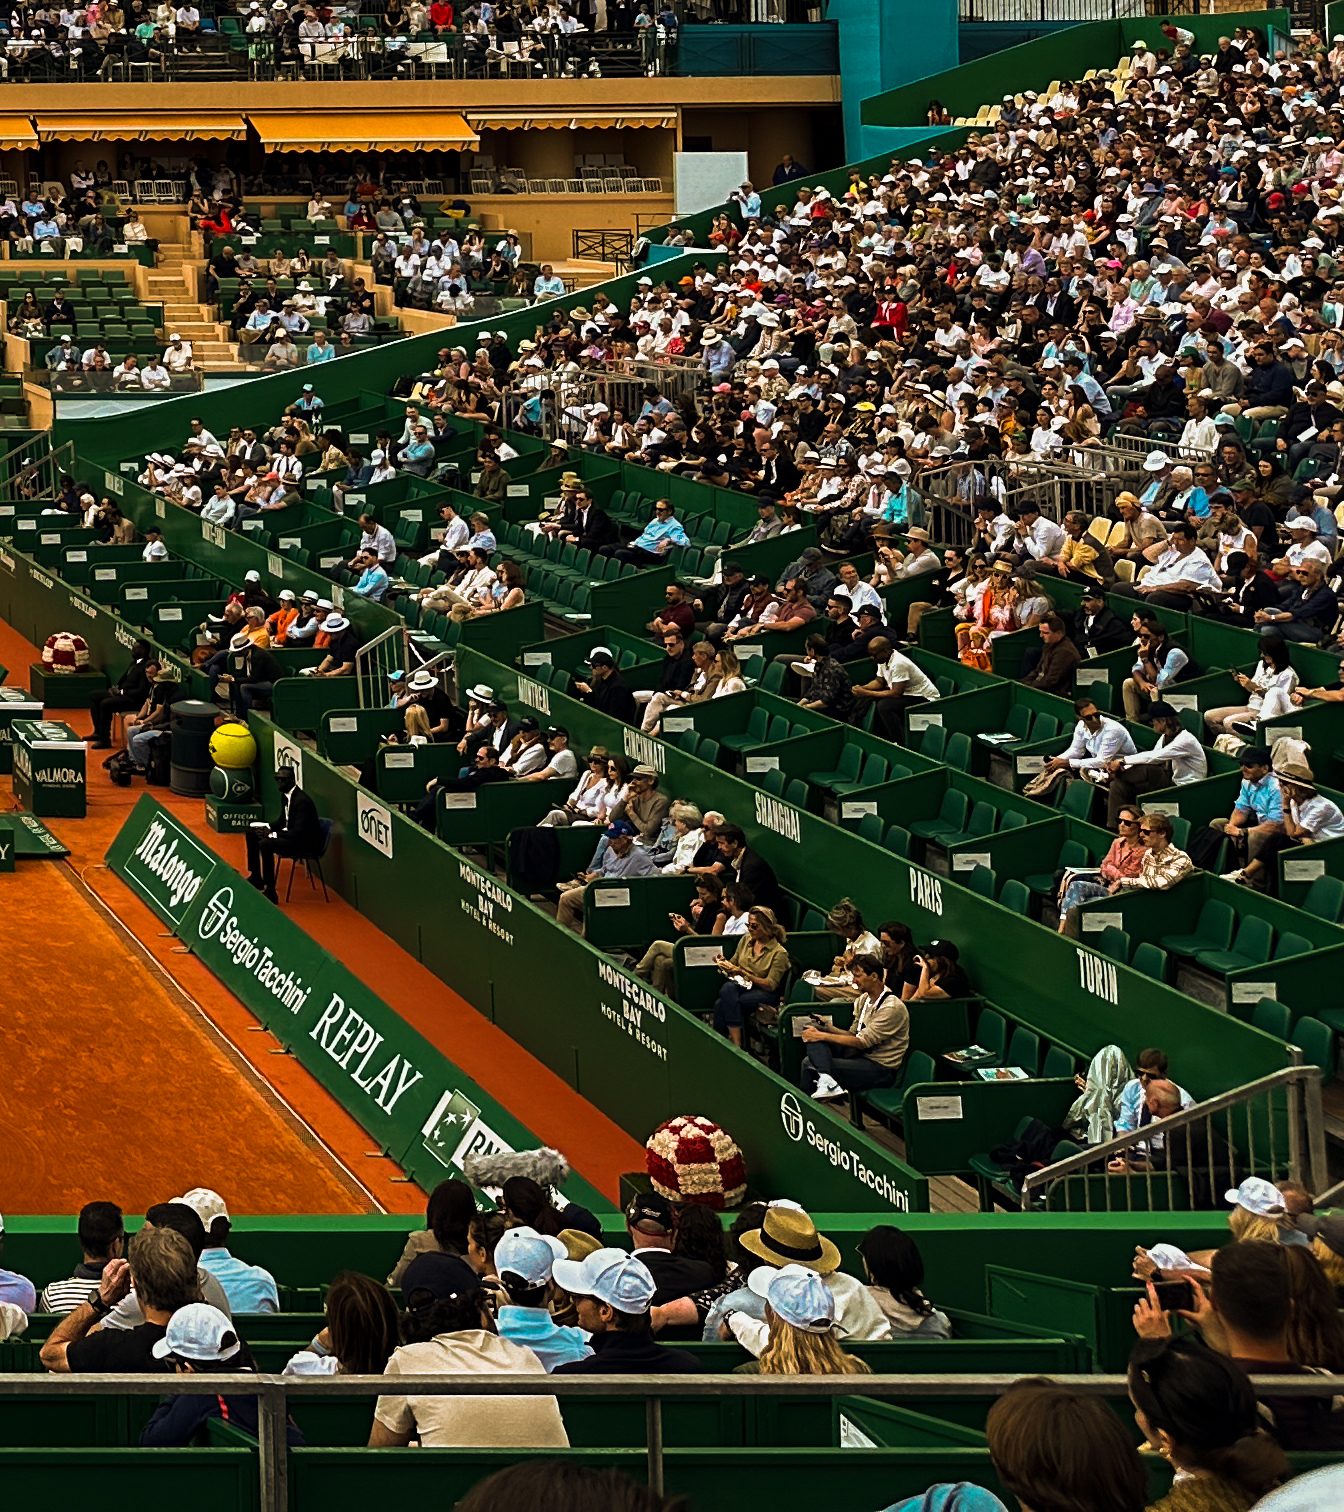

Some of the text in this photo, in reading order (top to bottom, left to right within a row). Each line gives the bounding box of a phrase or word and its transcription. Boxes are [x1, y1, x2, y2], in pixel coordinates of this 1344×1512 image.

[34, 767, 84, 784] VALMORA
[754, 791, 802, 844] SHANGHAI
[478, 894, 493, 919] BAY
[909, 866, 943, 916] PARIS
[461, 898, 481, 922] HOTEL
[488, 918, 514, 946] RESORT
[1077, 948, 1120, 1006] TURIN
[220, 916, 260, 970] Sergio
[253, 946, 312, 1015] Tacchini
[308, 992, 424, 1116] REPLAY
[601, 1002, 668, 1062] HOTEL & RESORT
[622, 999, 642, 1028] BAY
[806, 1120, 910, 1214] Sergio Tacchini
